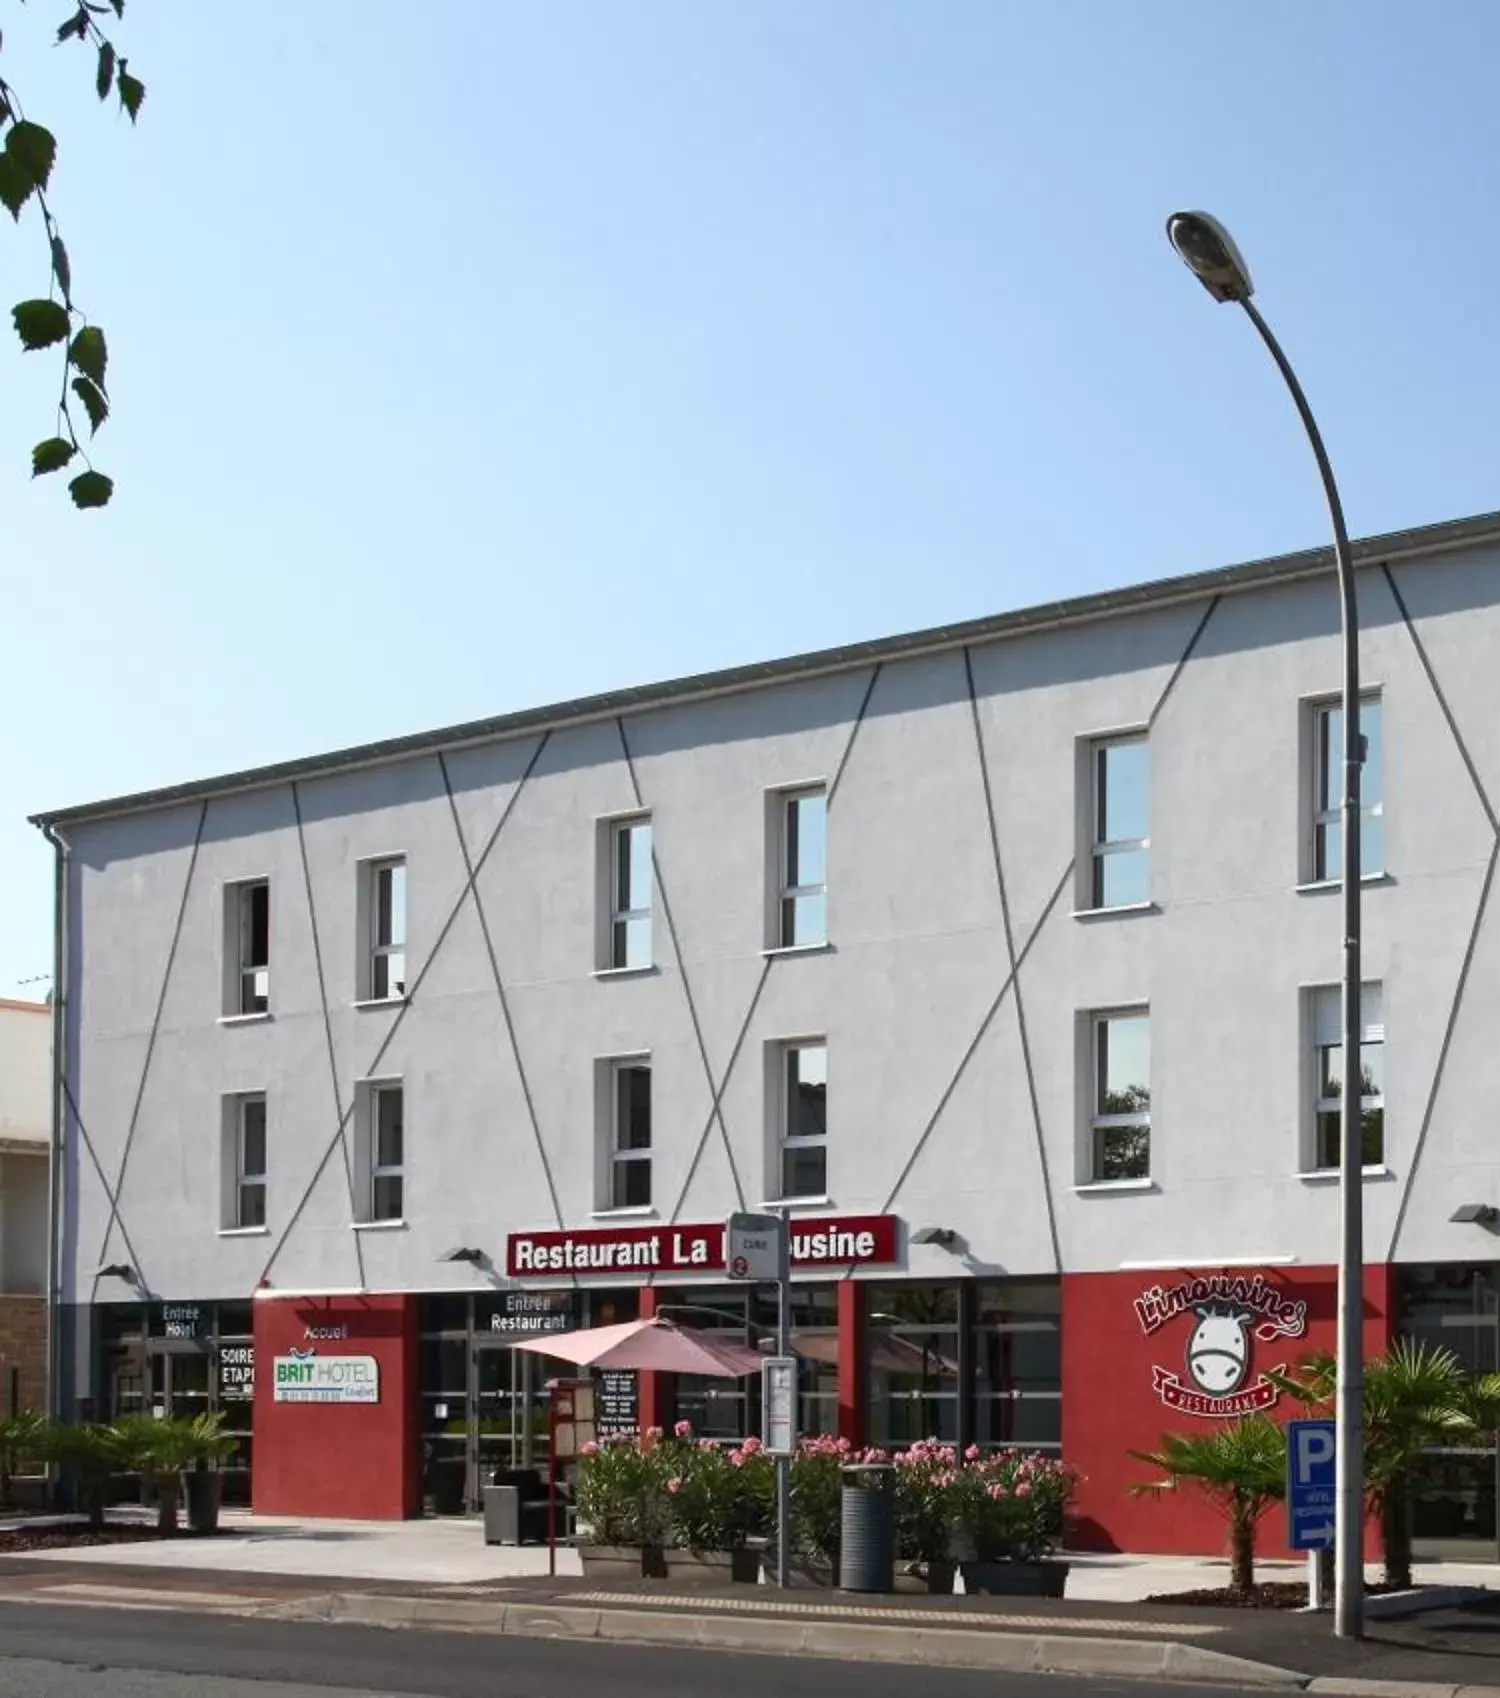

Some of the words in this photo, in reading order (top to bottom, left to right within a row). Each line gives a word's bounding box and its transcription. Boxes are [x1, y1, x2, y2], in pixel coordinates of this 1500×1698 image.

[515, 1235, 659, 1270] Restaurant
[673, 1233, 707, 1264] La
[722, 1225, 875, 1262] usine
[506, 1294, 552, 1312] Entrée
[491, 1313, 566, 1330] Restaurant
[221, 1350, 255, 1364] SOIRE
[277, 1364, 315, 1383] BRIT
[1177, 1391, 1258, 1415] RESTAURANT
[1298, 1429, 1335, 1483] P
